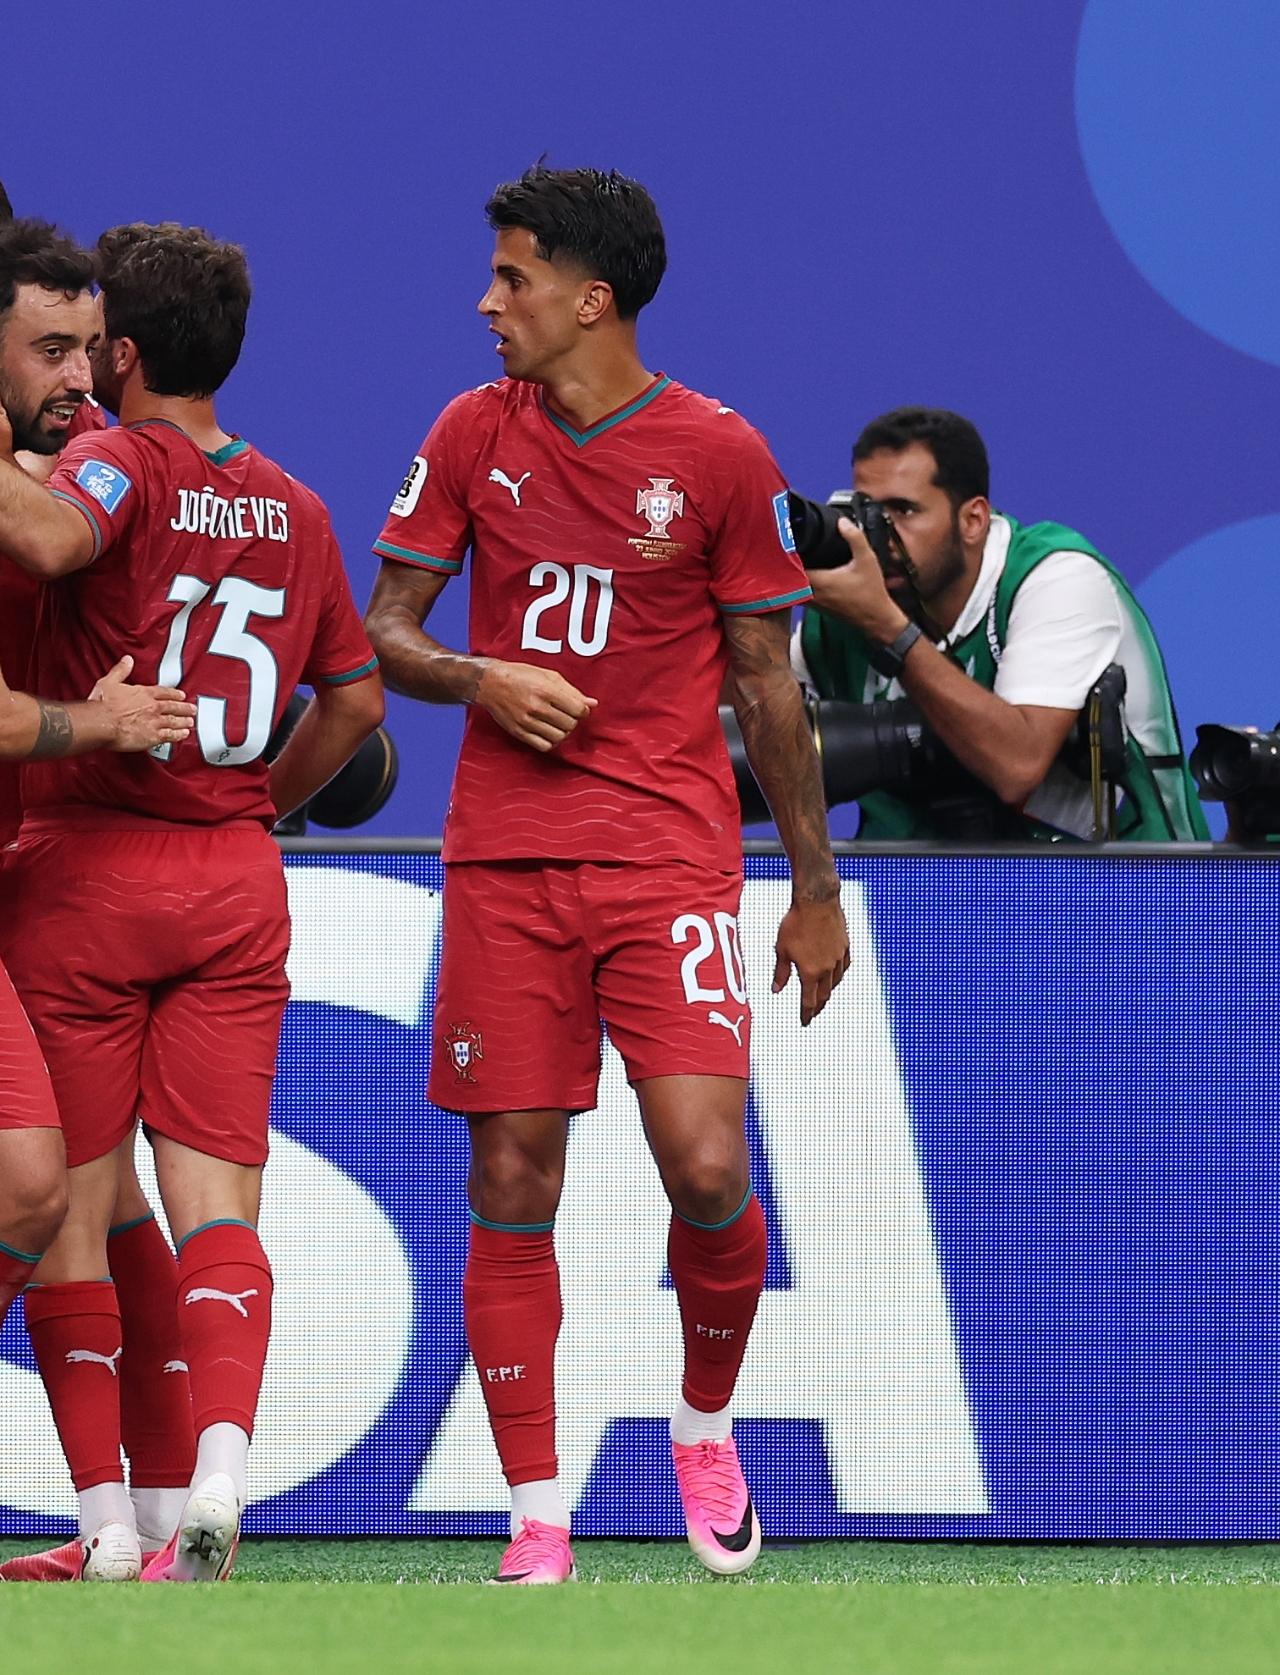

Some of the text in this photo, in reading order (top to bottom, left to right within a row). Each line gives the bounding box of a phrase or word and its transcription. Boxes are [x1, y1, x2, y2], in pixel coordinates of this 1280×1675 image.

[520, 560, 614, 657] 20
[149, 574, 287, 766] 15
[671, 911, 747, 1005] 20
